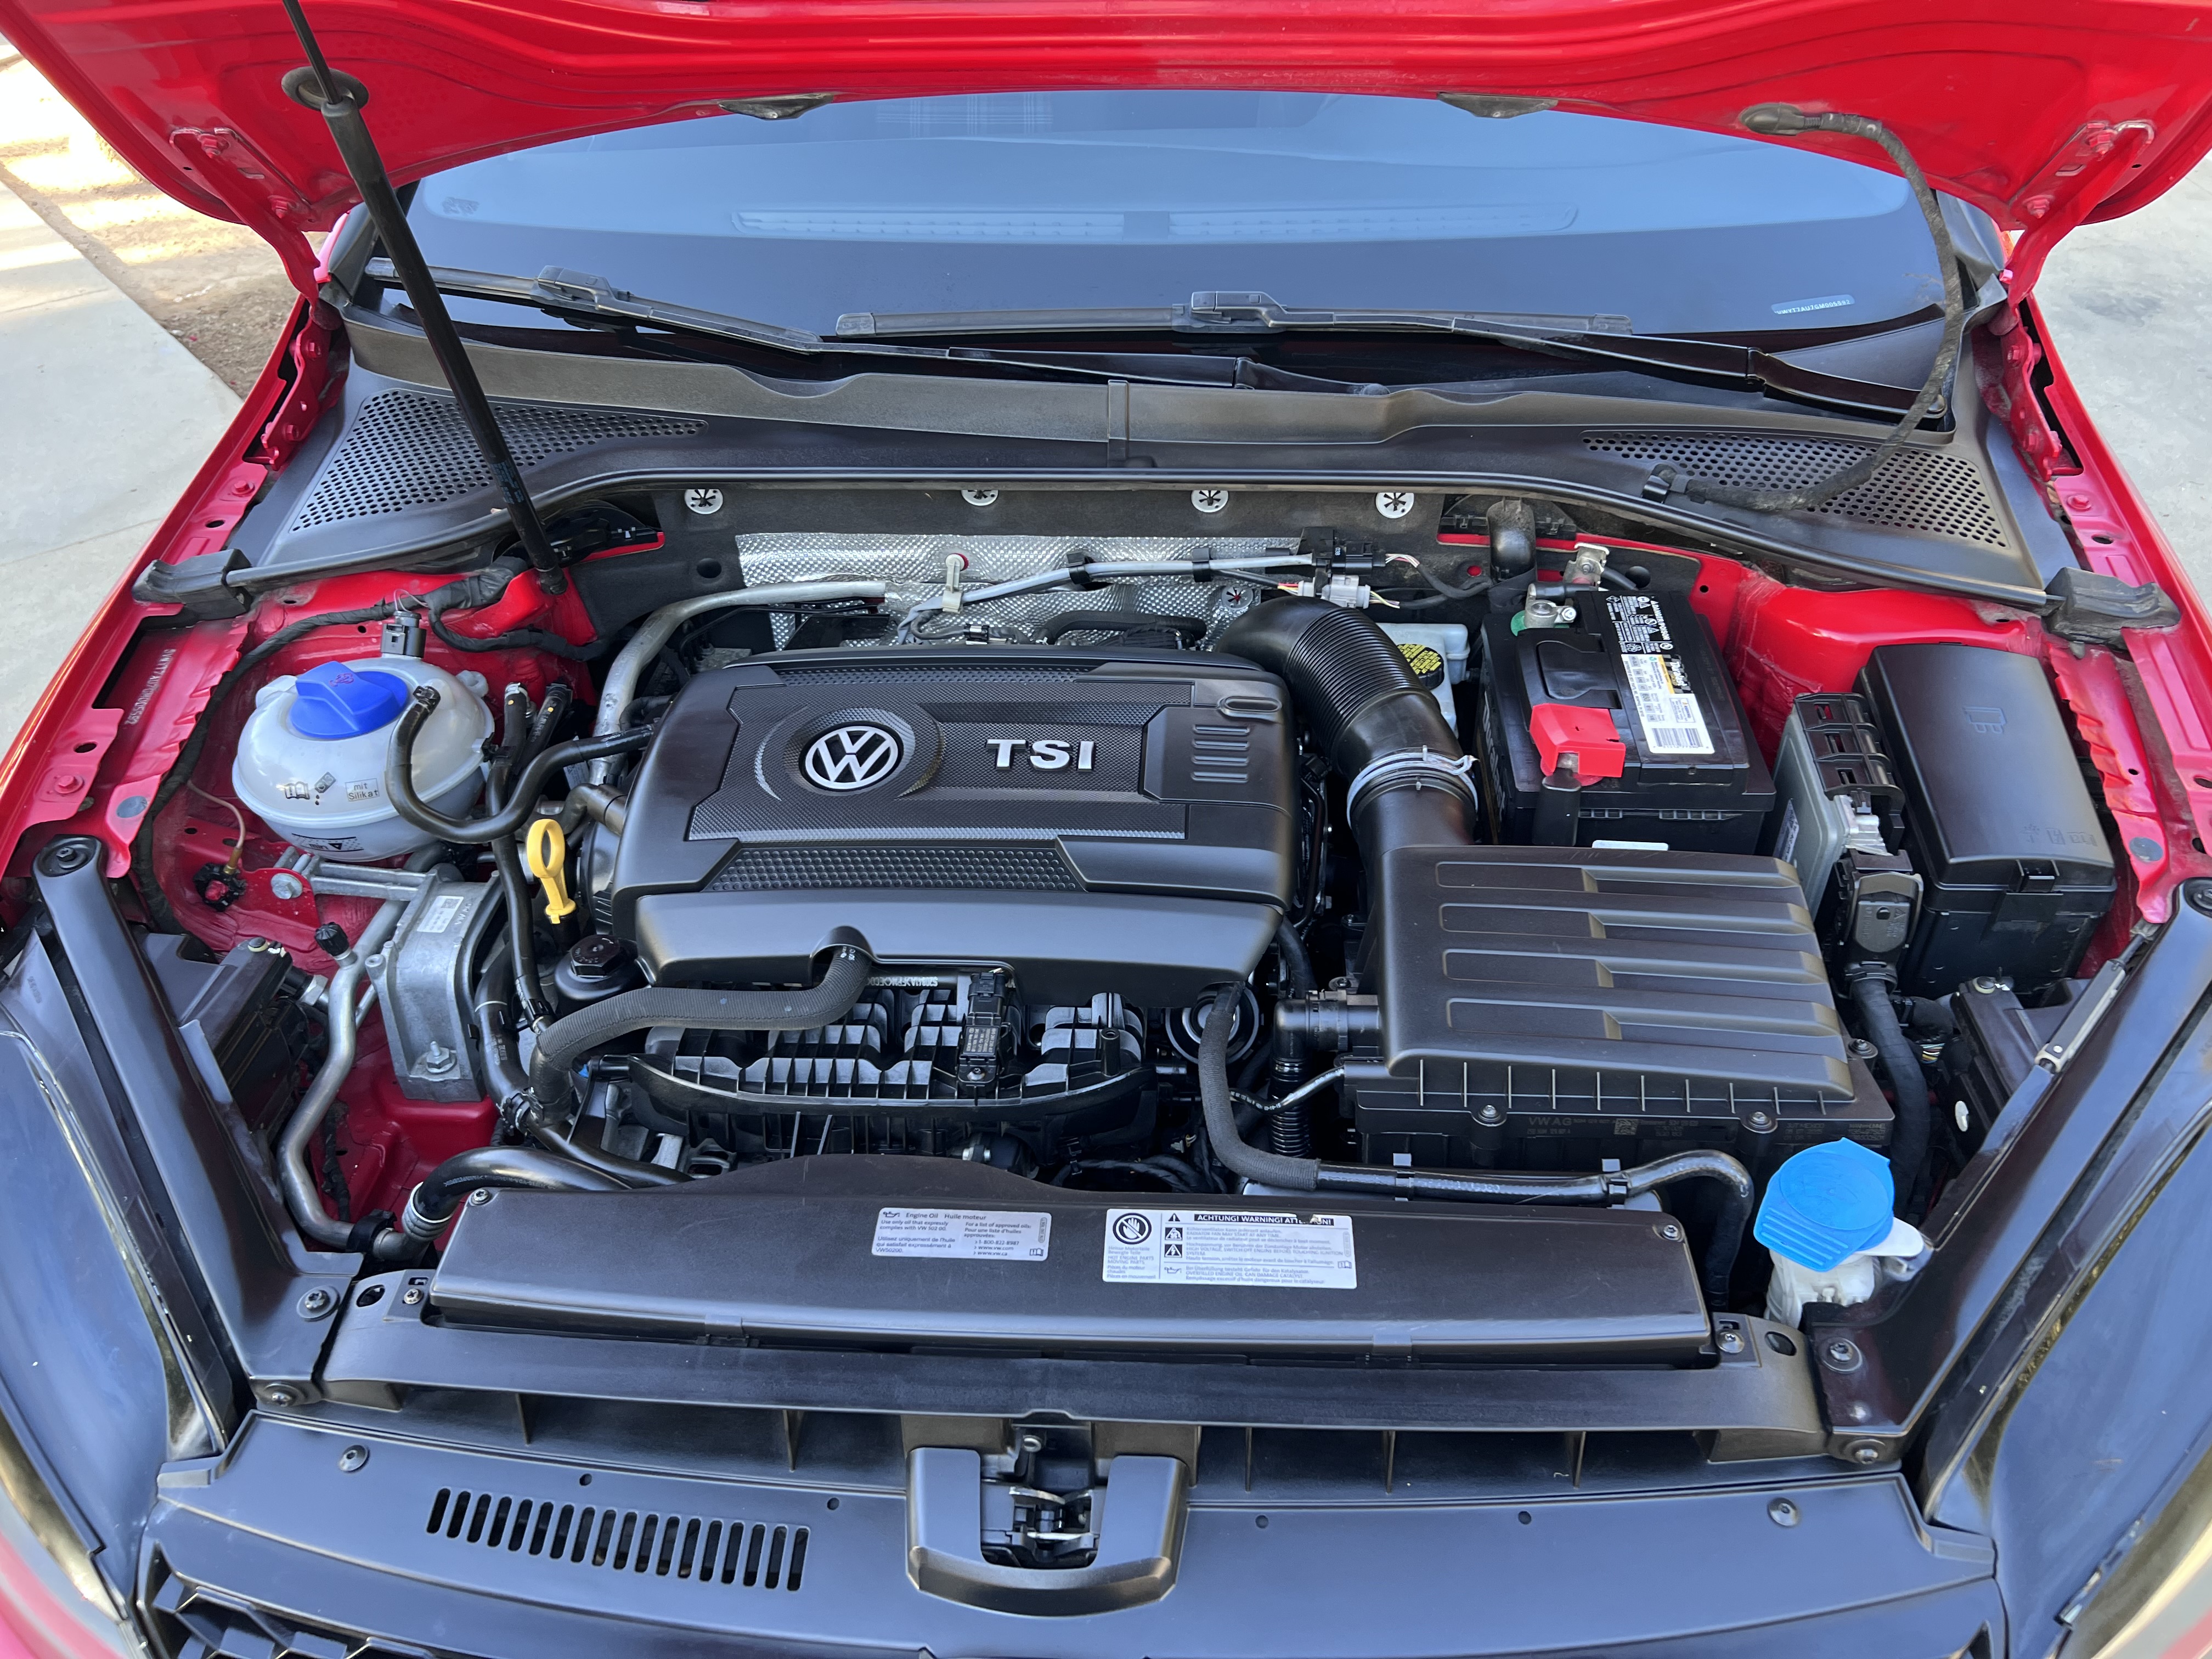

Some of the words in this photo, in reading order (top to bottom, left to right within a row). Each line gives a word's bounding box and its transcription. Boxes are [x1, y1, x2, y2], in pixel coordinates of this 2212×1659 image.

[1669, 661, 1688, 686] Duralast
[805, 725, 899, 790] VW
[986, 738, 1095, 771] TSI
[1482, 691, 1505, 822] Duralast
[348, 789, 379, 800] Silikat
[353, 782, 368, 791] mit
[1528, 1116, 1550, 1126] VW
[1553, 1117, 1572, 1126] AG
